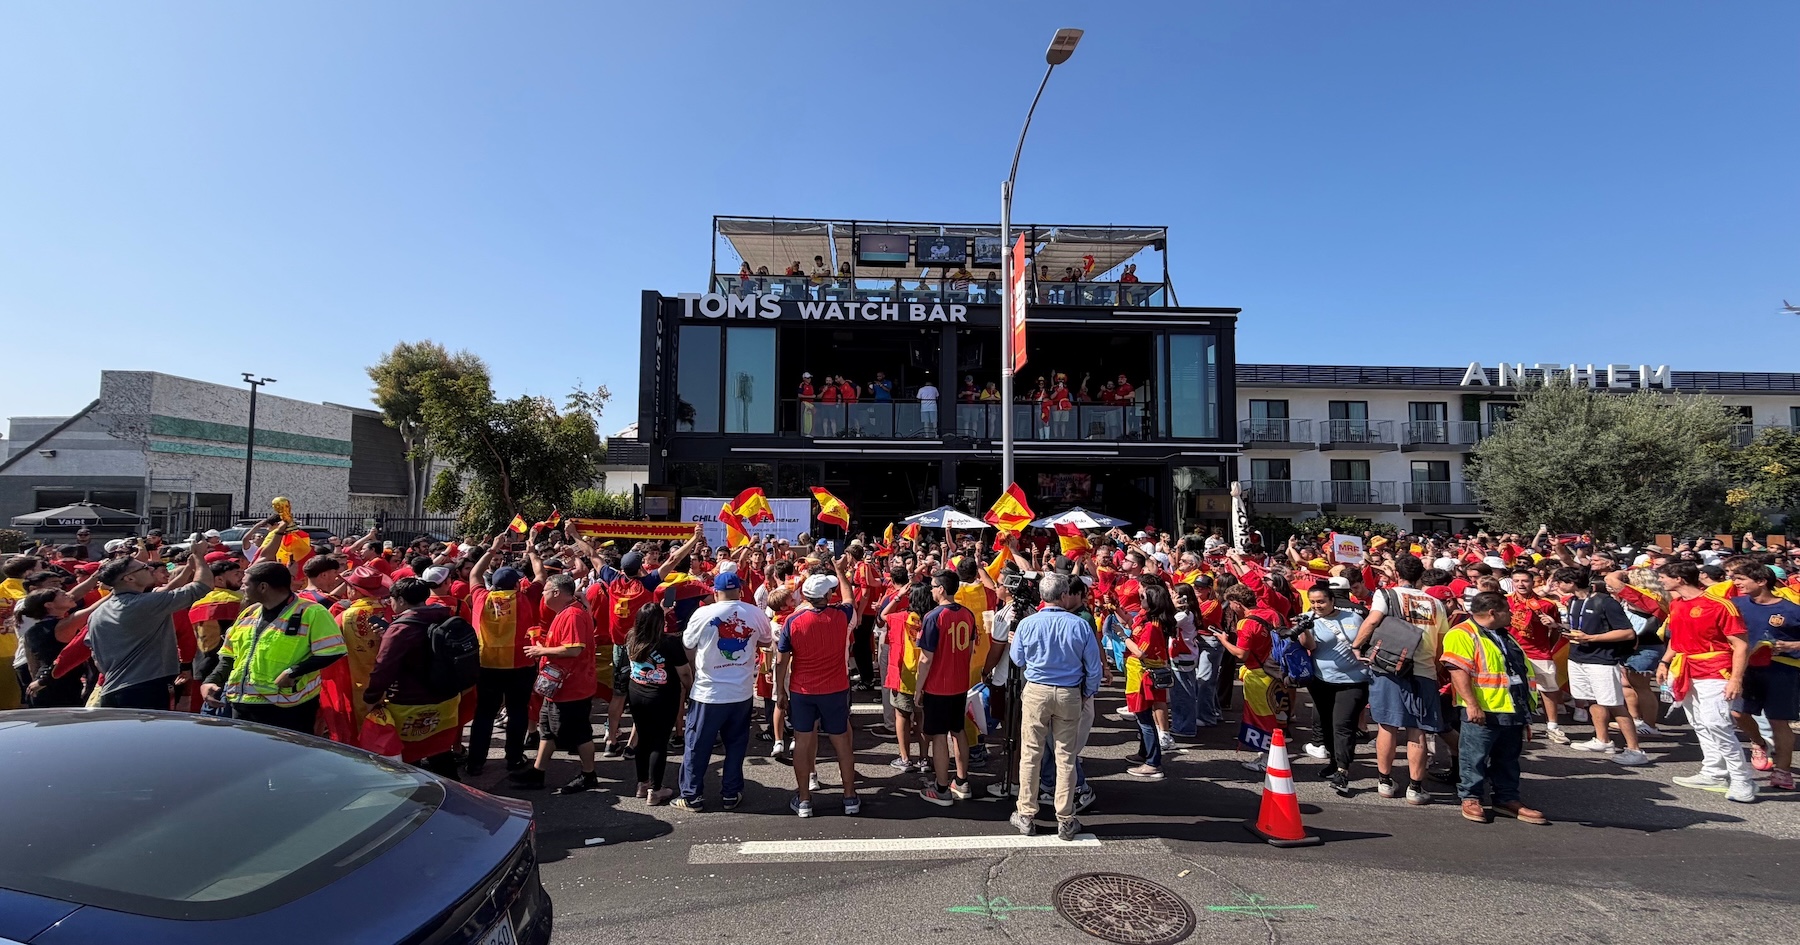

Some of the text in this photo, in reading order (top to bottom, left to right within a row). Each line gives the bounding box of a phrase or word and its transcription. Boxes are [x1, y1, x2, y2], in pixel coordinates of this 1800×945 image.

[797, 301, 899, 321] WATCH
[909, 303, 967, 322] BAR
[1460, 361, 1672, 389] ANTHEM
[692, 514, 718, 523] CHILL
[1338, 544, 1360, 553] MRF
[947, 621, 970, 653] 10
